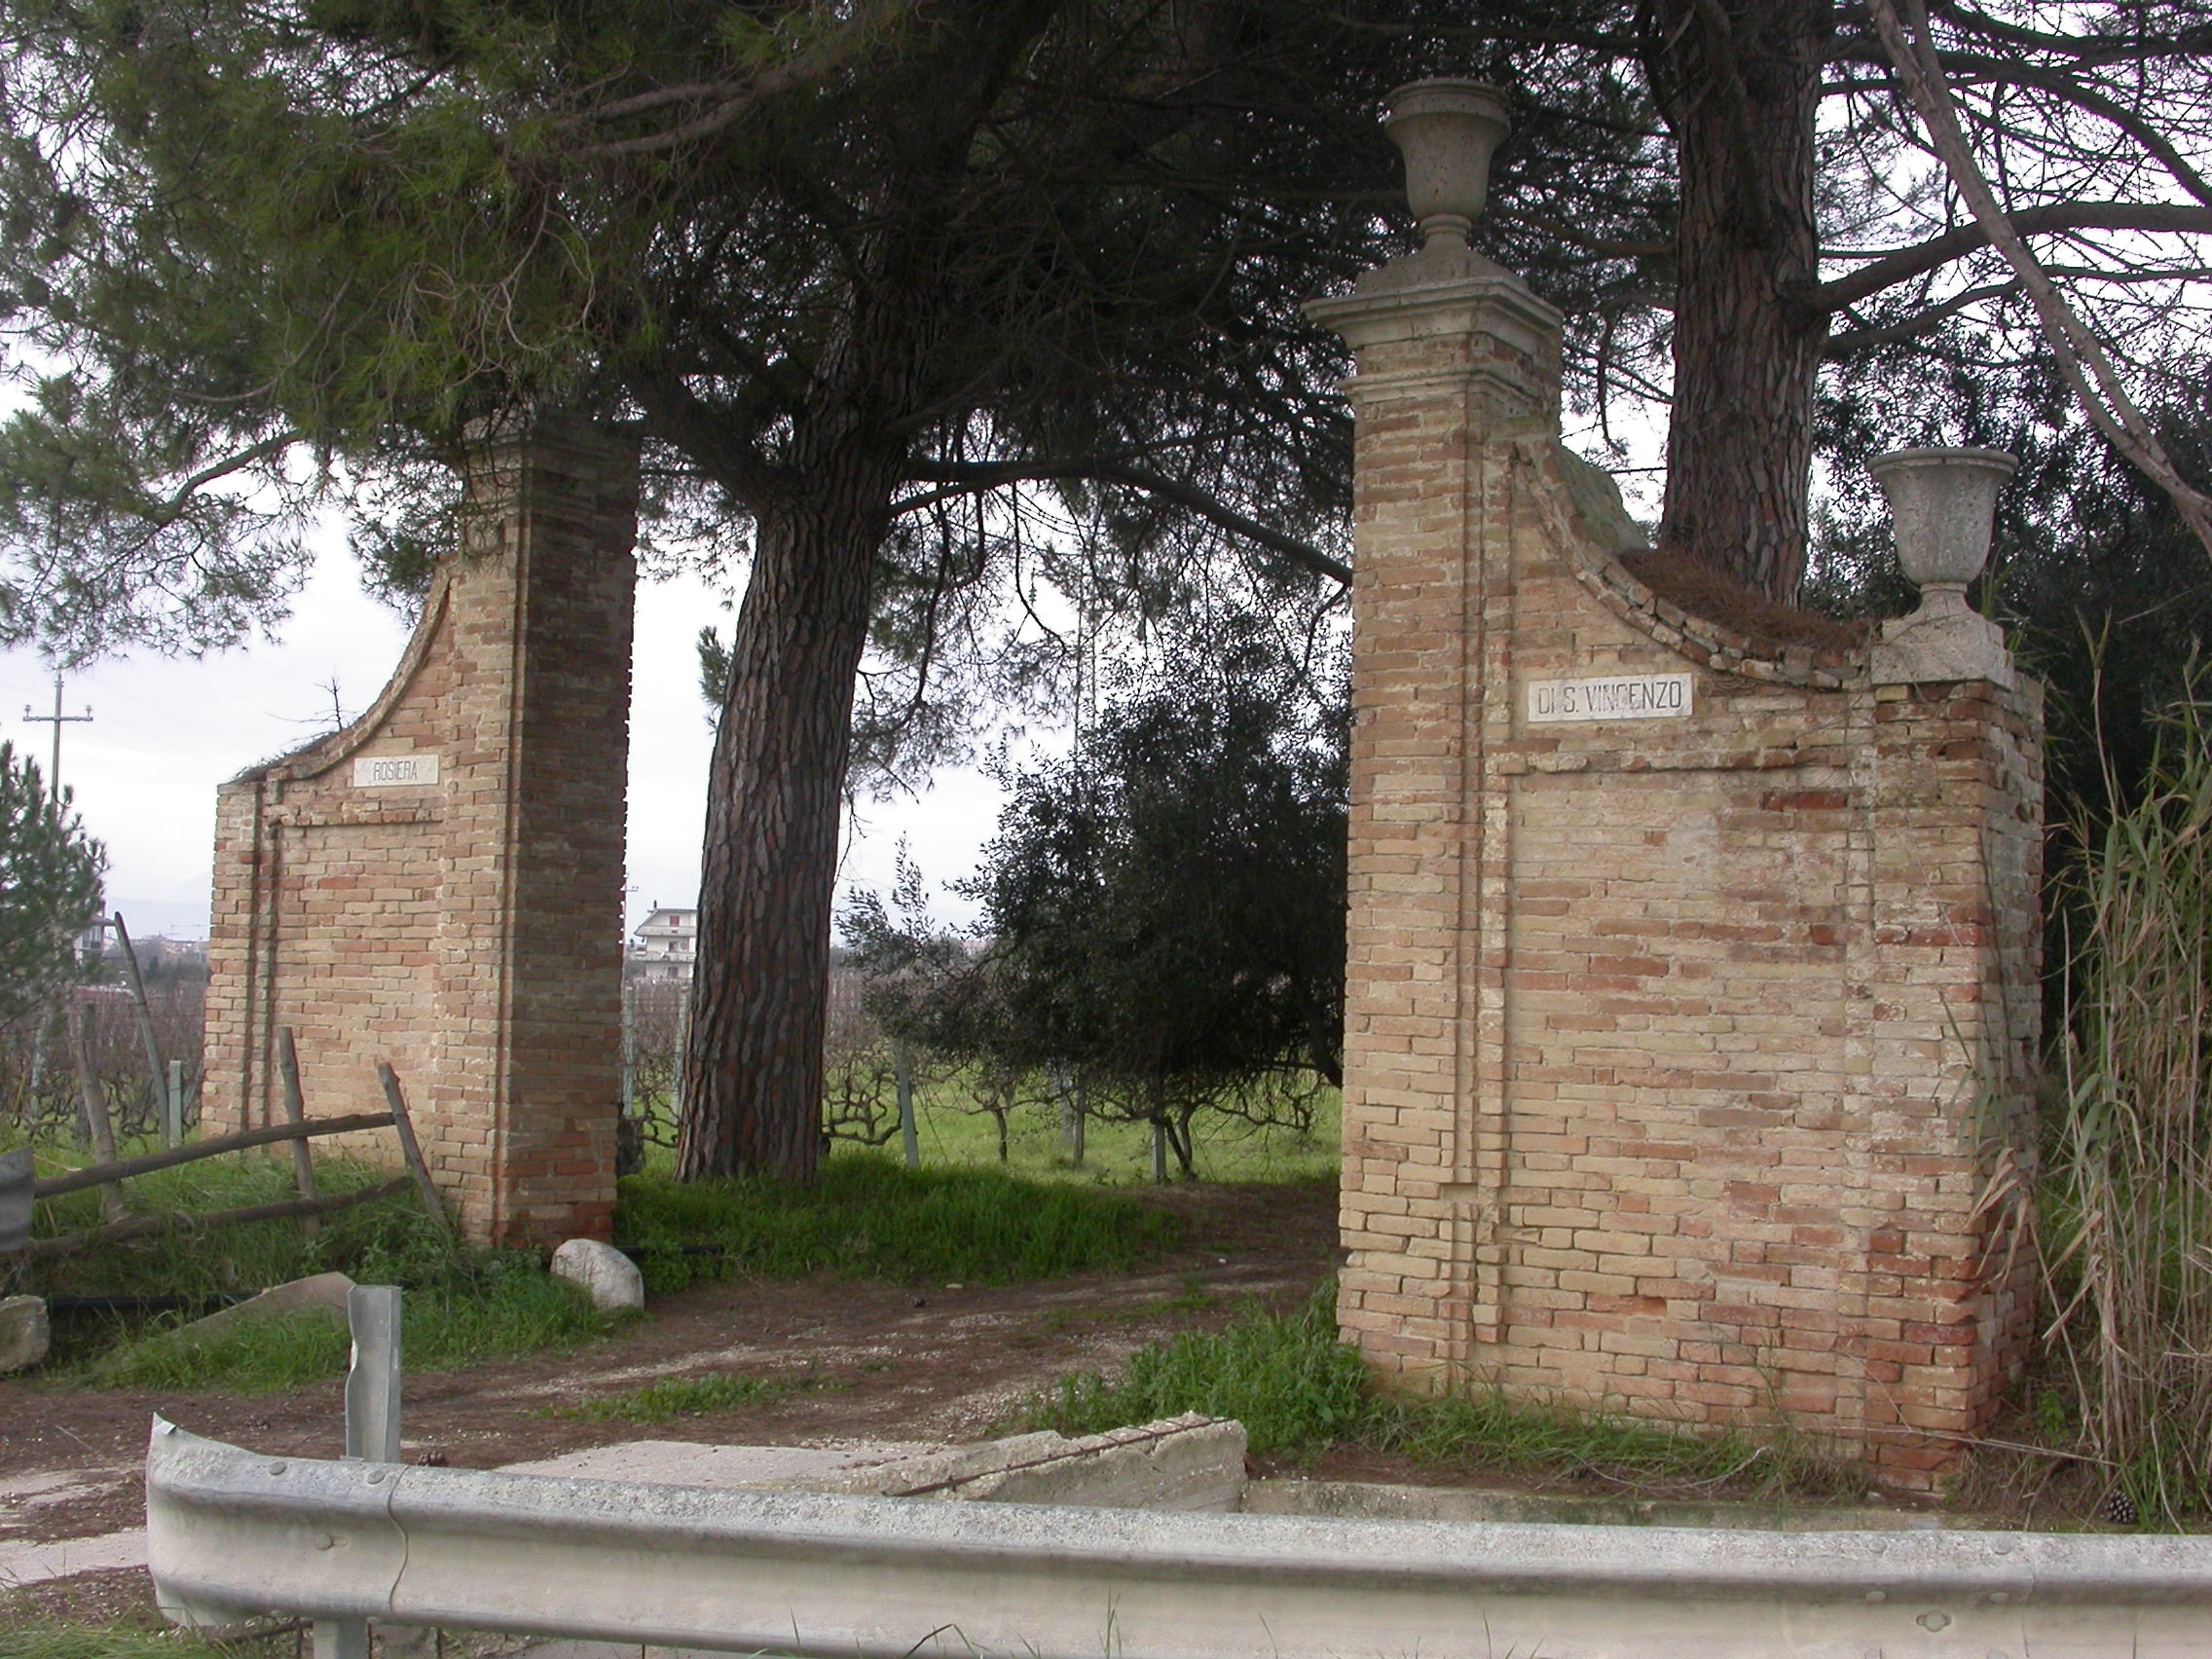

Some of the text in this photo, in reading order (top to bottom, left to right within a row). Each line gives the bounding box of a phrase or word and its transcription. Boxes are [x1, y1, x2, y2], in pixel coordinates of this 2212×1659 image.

[1538, 682, 1681, 715] DI S. VINCENZO
